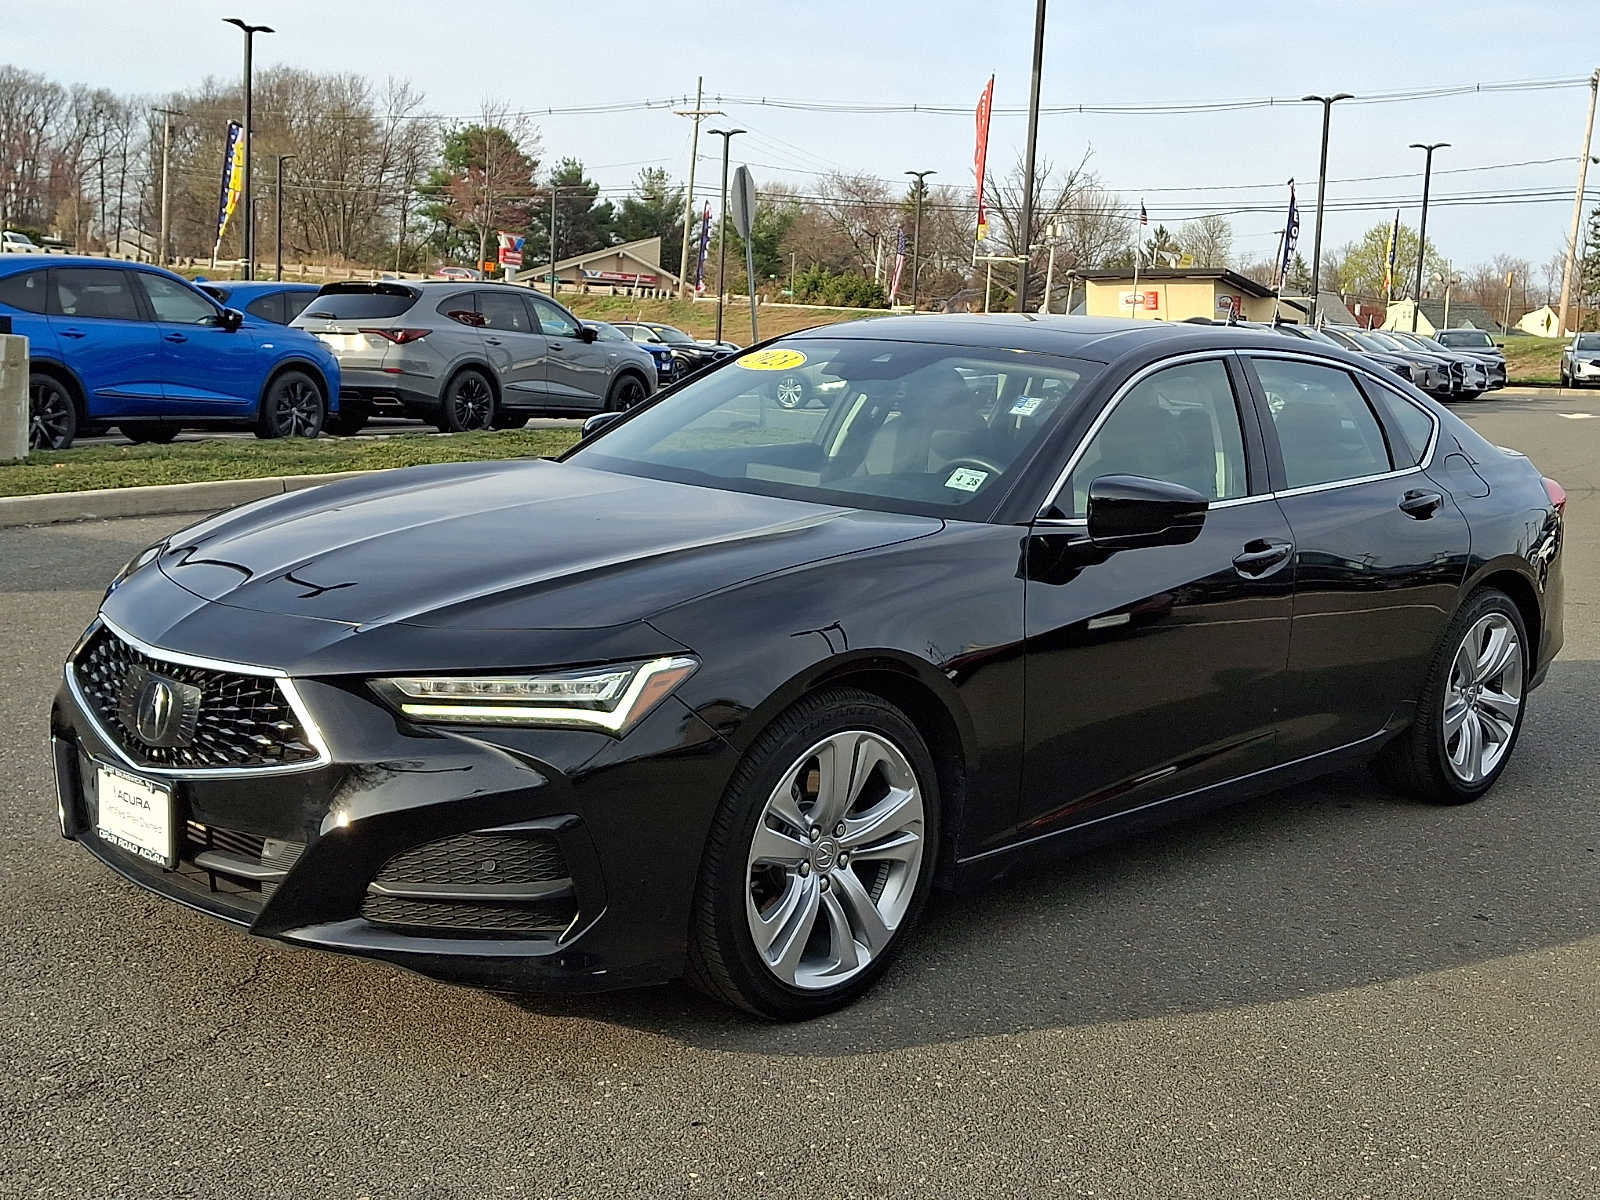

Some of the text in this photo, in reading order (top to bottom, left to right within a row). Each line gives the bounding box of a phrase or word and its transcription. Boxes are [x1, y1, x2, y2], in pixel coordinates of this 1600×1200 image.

[117, 789, 151, 811] ACURA
[99, 829, 117, 844] OPEN
[118, 837, 139, 854] ROAD
[139, 846, 166, 866] ACURA
